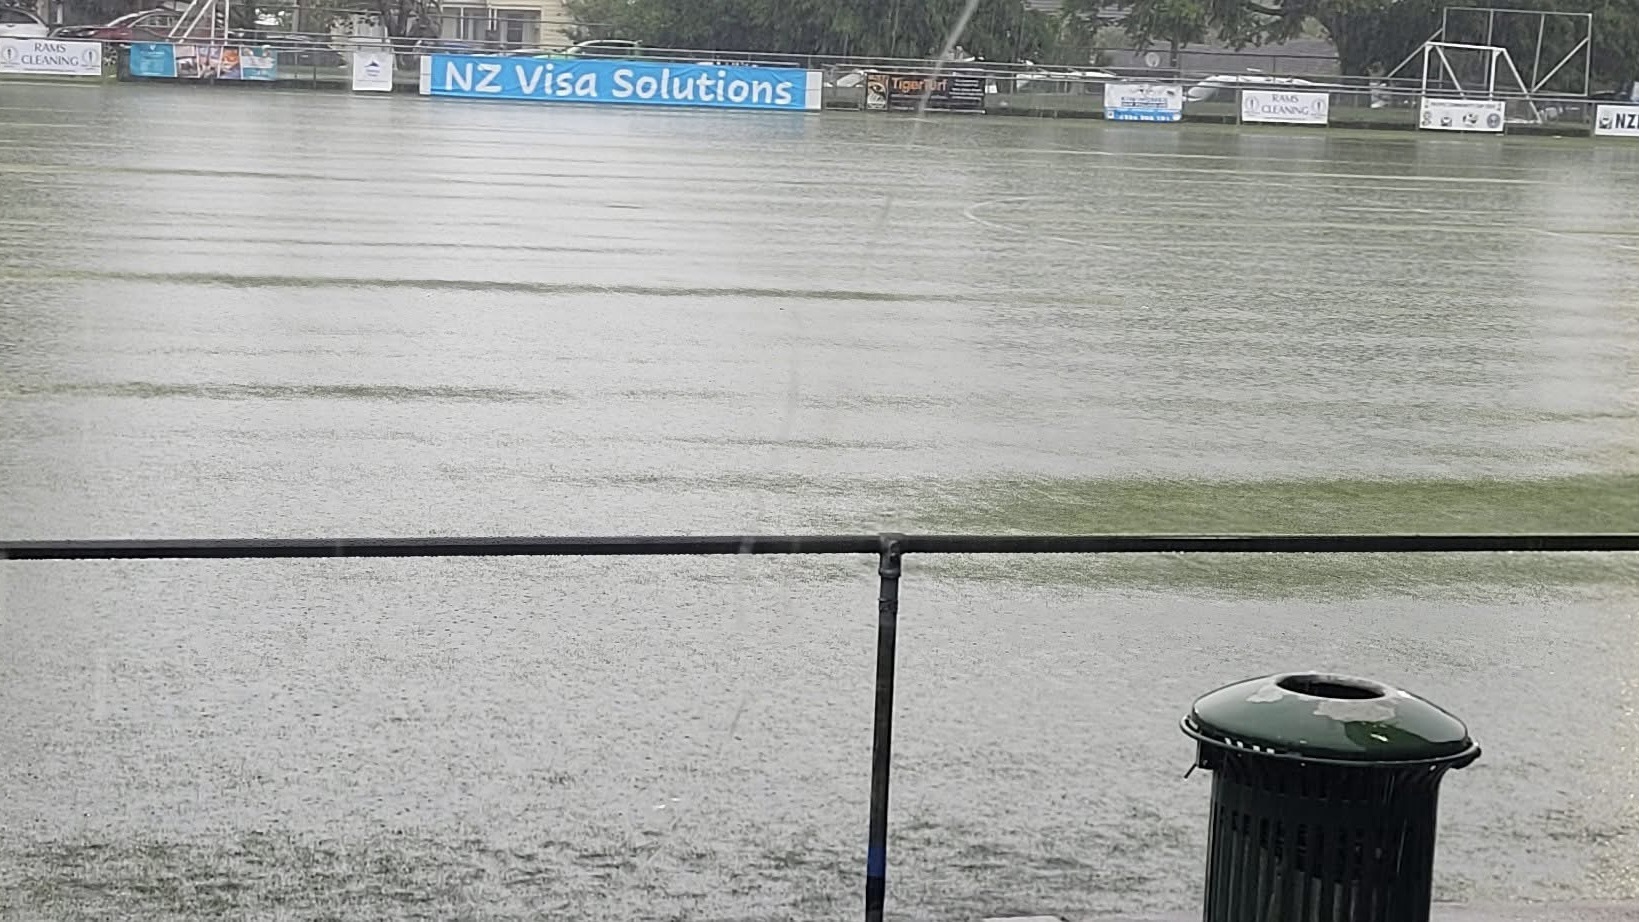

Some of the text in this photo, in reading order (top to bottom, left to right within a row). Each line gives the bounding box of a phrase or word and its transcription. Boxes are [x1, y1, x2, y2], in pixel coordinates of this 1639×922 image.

[34, 42, 67, 53] RAMS
[20, 54, 80, 67] CLEANING
[445, 61, 793, 105] NZ Visa Solutions
[1272, 93, 1300, 104] RAMS
[1261, 104, 1309, 116] CLEANING
[1615, 112, 1639, 129] NZ
